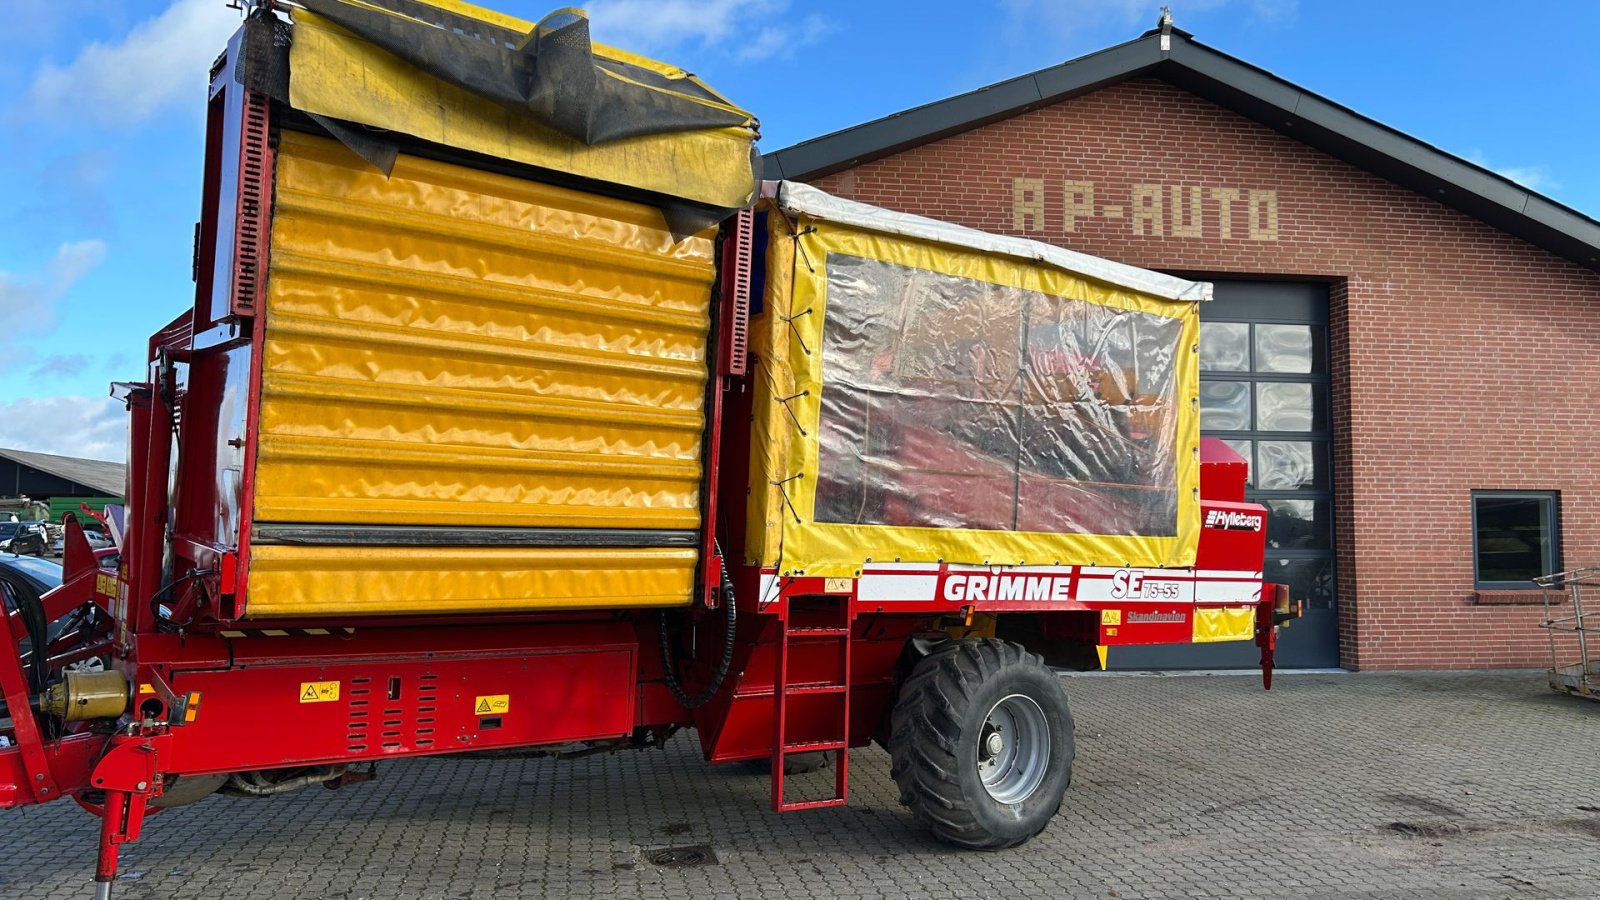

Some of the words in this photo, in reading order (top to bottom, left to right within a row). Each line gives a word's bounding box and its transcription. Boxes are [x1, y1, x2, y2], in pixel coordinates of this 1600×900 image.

[1012, 176, 1279, 241] AP-AUTO
[1215, 511, 1262, 532] Hylleberg
[1111, 569, 1144, 599] SE
[1143, 583, 1179, 599] 75-55
[1127, 610, 1186, 623] Skandinavien
